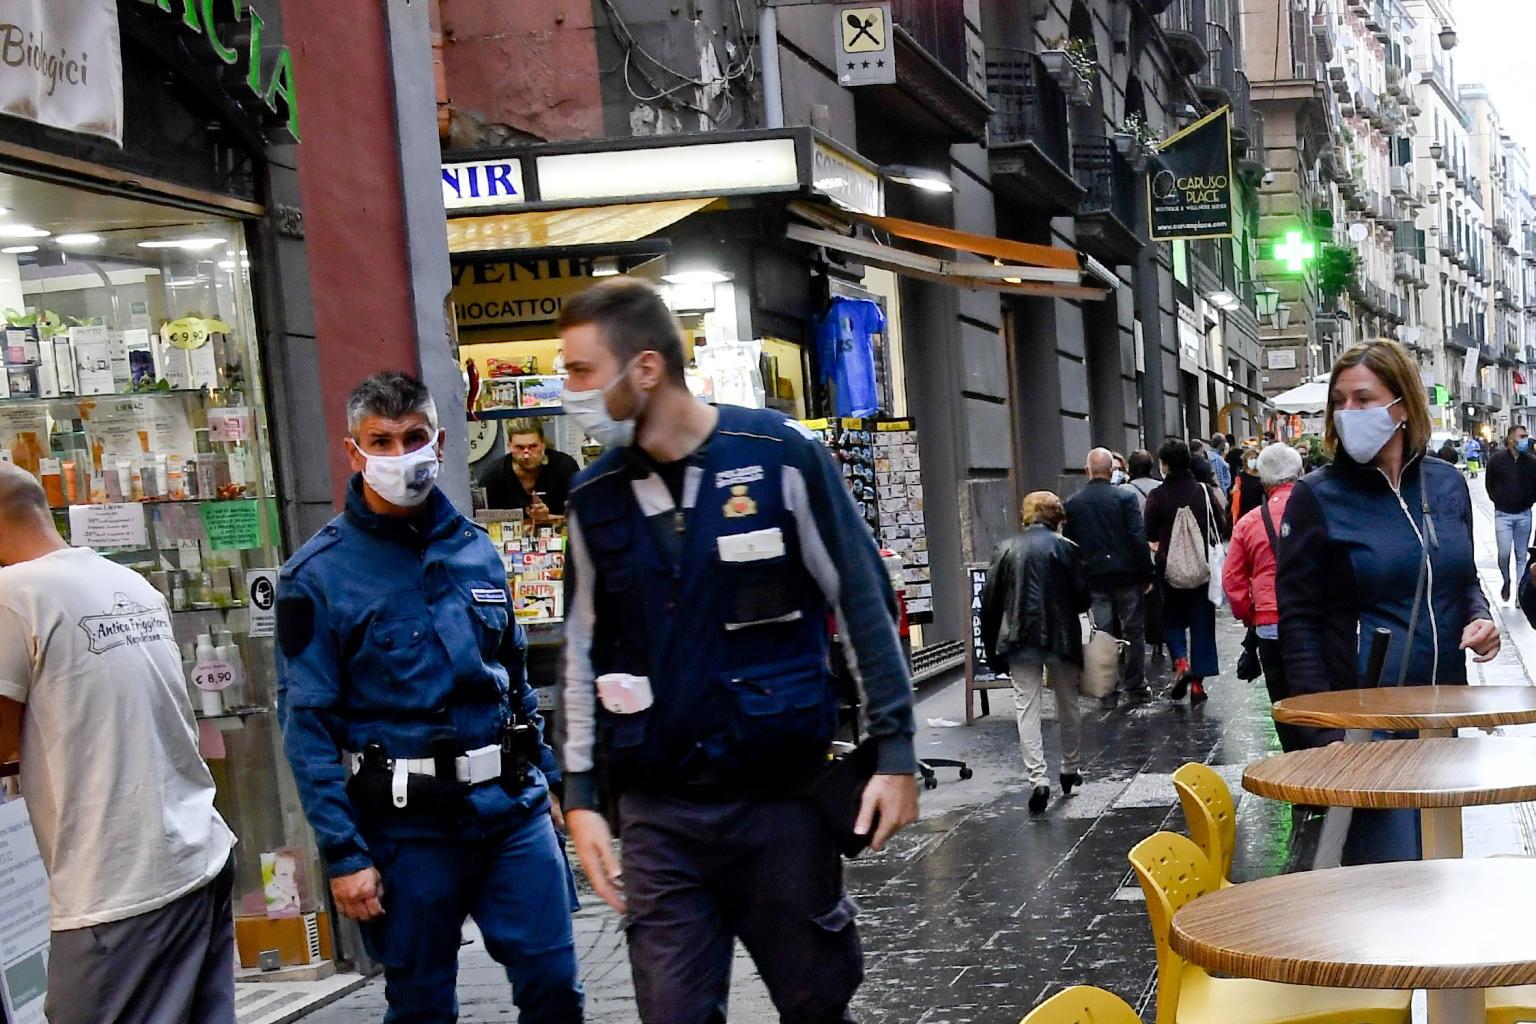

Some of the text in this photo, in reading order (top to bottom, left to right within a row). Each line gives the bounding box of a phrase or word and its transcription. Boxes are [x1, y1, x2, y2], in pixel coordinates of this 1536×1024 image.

[1177, 175, 1227, 190] CARUSO
[1186, 190, 1220, 204] PLACE
[456, 296, 561, 321] IOCATTO
